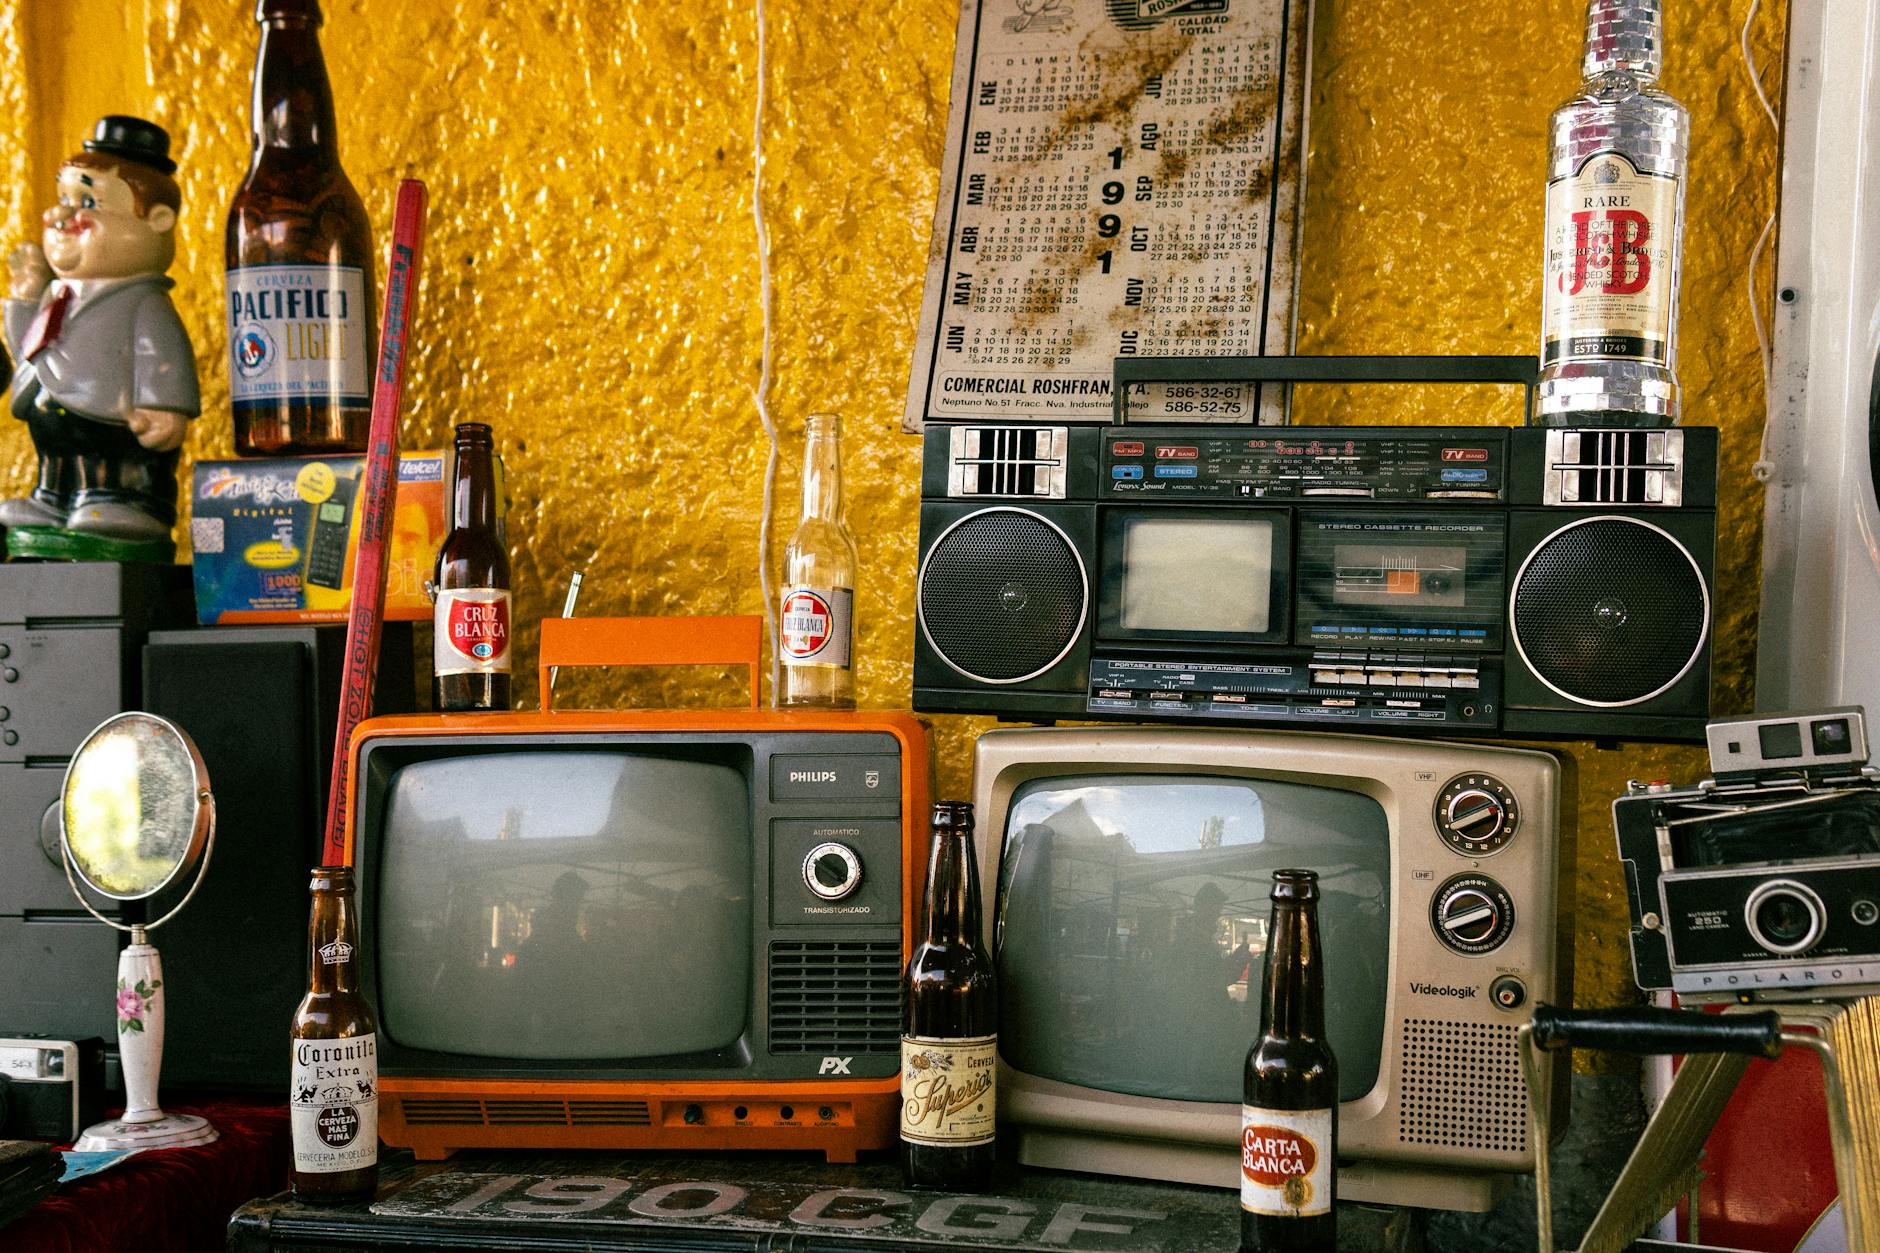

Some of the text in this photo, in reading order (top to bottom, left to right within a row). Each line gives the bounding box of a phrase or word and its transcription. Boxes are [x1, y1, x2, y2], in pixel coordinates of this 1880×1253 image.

[1173, 16, 1228, 26] ¡CALIDAD
[980, 80, 997, 106] ENE
[1146, 74, 1163, 99] JUL
[974, 131, 991, 154] FEB
[1141, 123, 1158, 151] AGO
[966, 174, 986, 205] MAR
[1135, 175, 1153, 201] SEP
[1584, 196, 1630, 208] RARE
[961, 226, 979, 253] ABR
[1131, 226, 1149, 252] OCT
[256, 274, 313, 287] CERVEZA
[953, 271, 973, 305] MAY
[1125, 278, 1144, 306] NOV
[232, 289, 348, 327] PACIFICO
[946, 326, 965, 353] JUN
[1120, 330, 1138, 354] DIC
[1604, 344, 1627, 352] 1749
[944, 377, 1114, 396] COMERCIAL ROSHFRAN,
[1165, 387, 1241, 399] 586-32-61
[942, 398, 982, 408] Neptuno
[1046, 400, 1066, 408] Nva.
[1165, 401, 1241, 413] 586-52-75
[1158, 448, 1176, 456] TV
[1445, 450, 1464, 460] TV
[1140, 481, 1166, 490] Sound
[463, 607, 498, 622] CRUZ
[455, 622, 505, 638] BLANCA
[353, 612, 370, 679] SHOT
[790, 771, 837, 782] PHILIPS
[1695, 917, 1722, 925] 250
[1703, 969, 1863, 986] POLAROI
[1410, 982, 1476, 998] Videologik
[298, 1040, 374, 1066] Coronita
[818, 1056, 854, 1075] PX
[967, 1056, 994, 1068] CERVEZA
[316, 1067, 360, 1080] Extra
[905, 1069, 992, 1129] Superior
[318, 1116, 357, 1126] CERVEZA
[328, 1125, 348, 1134] MAS
[327, 1133, 350, 1142] FINA
[1246, 1129, 1302, 1158] CARTA
[297, 1152, 336, 1162] CERVECERIA
[1243, 1147, 1306, 1175] BLANCA
[788, 1189, 1169, 1245] CGF
